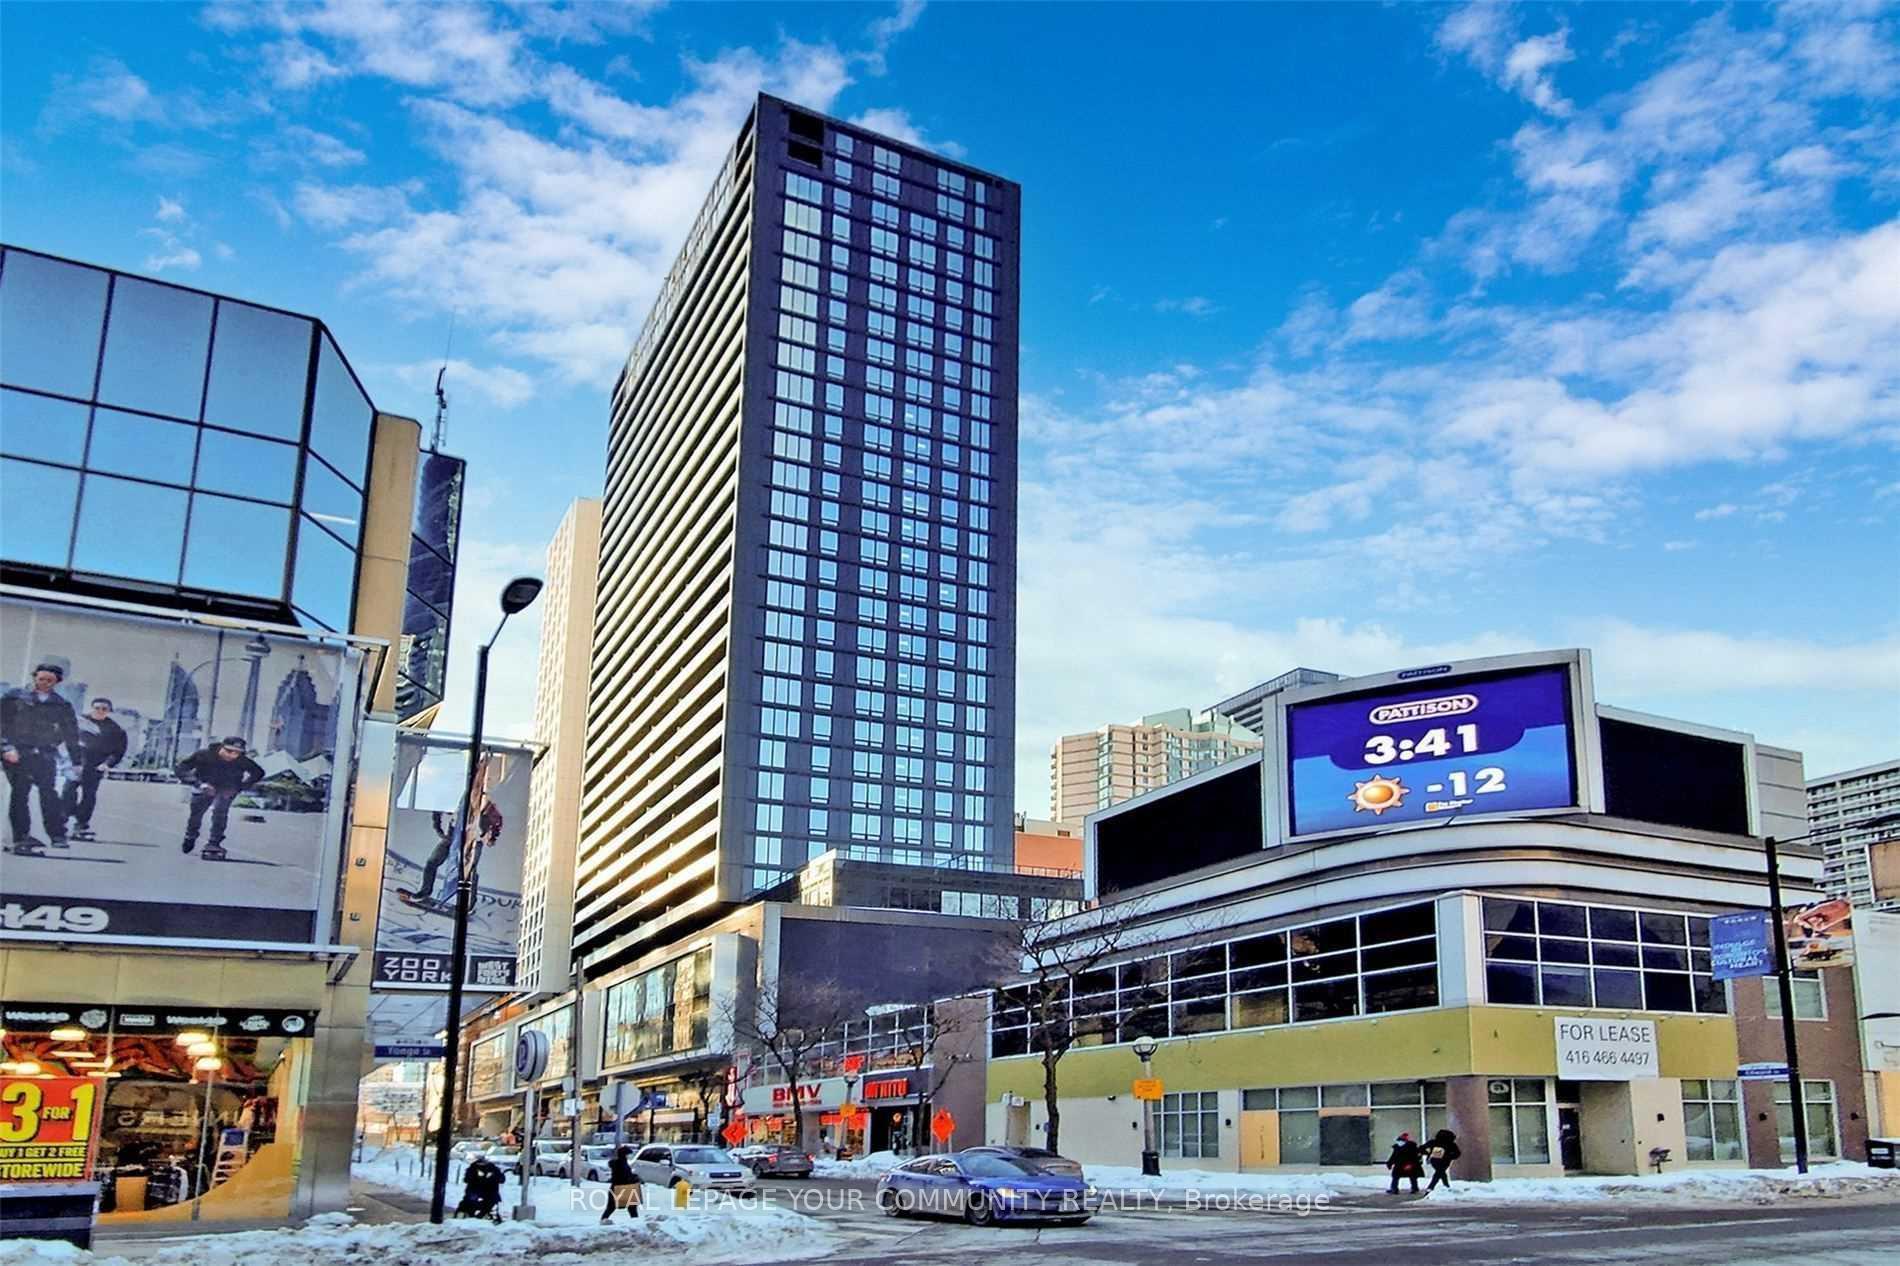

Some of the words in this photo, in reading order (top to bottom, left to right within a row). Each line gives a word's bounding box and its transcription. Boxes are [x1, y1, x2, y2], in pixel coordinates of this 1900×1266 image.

[1377, 698, 1469, 721] PATTISON
[1364, 723, 1479, 765] 3:41
[1426, 767, 1506, 797] -12
[0, 903, 109, 932] t49
[384, 957, 440, 970] ZOO
[384, 970, 453, 983] YORK
[1560, 1023, 1594, 1041] FOR
[1599, 1025, 1650, 1043] LEASE
[1566, 1050, 1590, 1065] 416
[0, 1082, 42, 1141] 3
[43, 1106, 71, 1120] FOR
[70, 1083, 95, 1141] 1
[0, 1148, 16, 1158] UY
[18, 1148, 24, 1158] 1
[25, 1148, 46, 1158] GET
[48, 1147, 57, 1158] 2
[59, 1147, 86, 1158] FREE
[0, 1163, 84, 1178] TOREWIDE
